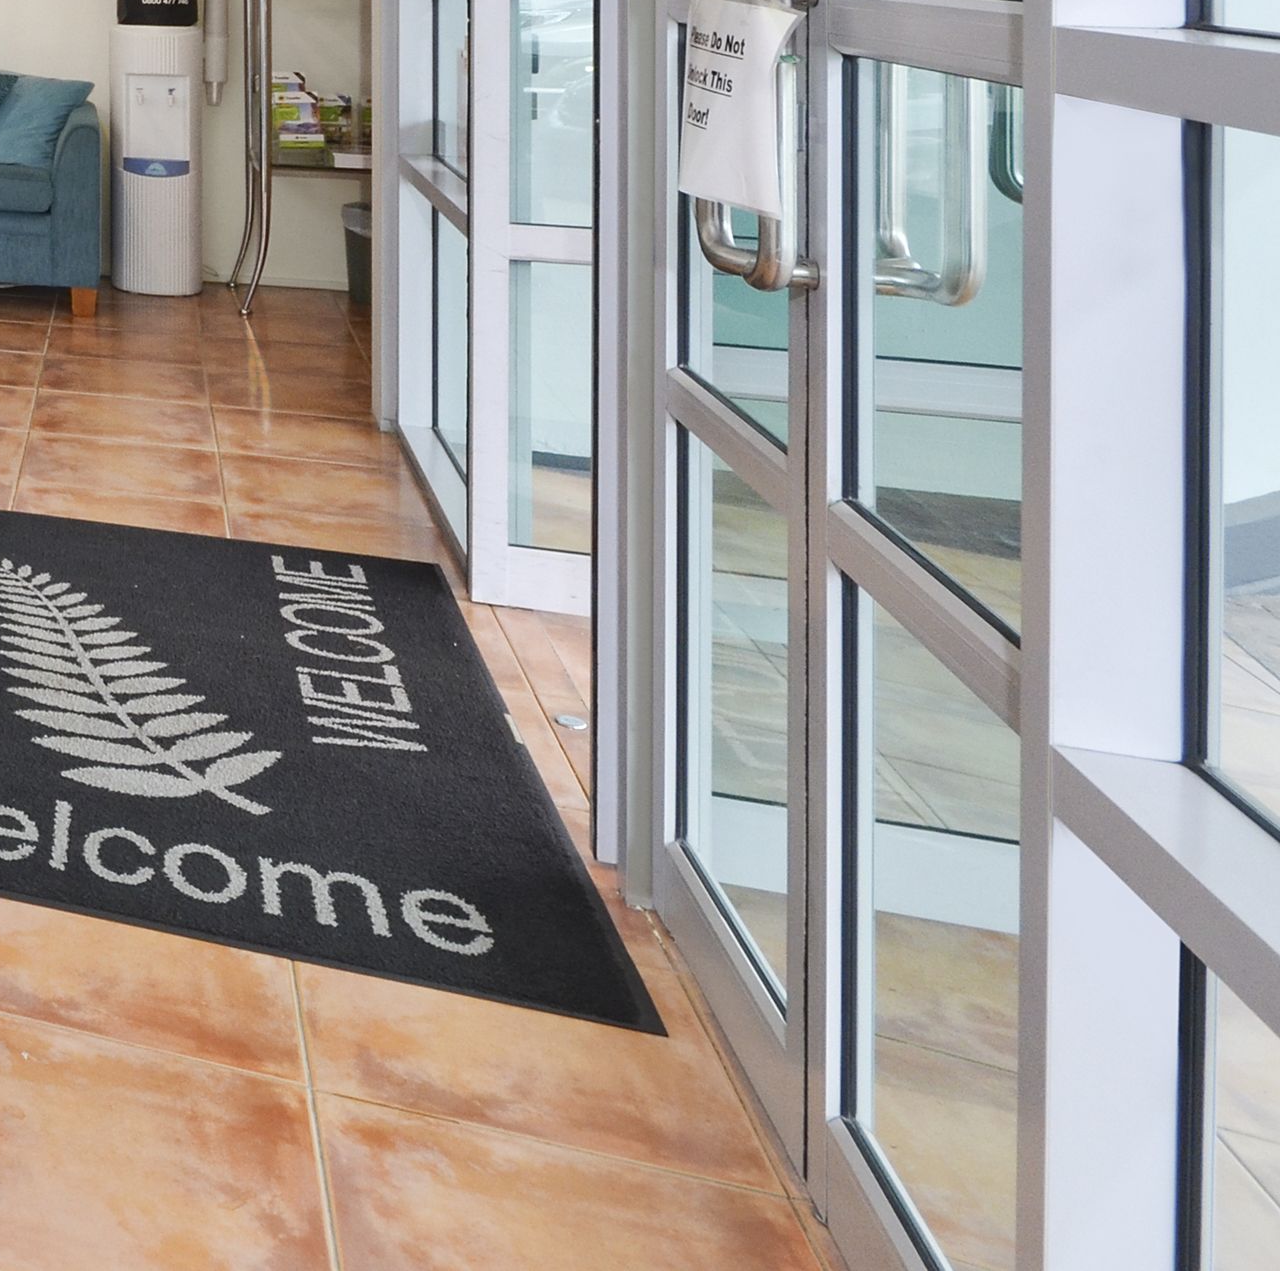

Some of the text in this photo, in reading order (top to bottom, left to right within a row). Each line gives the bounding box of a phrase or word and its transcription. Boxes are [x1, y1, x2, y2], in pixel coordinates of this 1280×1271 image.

[710, 31, 723, 50] Do
[724, 34, 746, 56] Not
[710, 70, 733, 93] This
[270, 554, 428, 751] WELCOME
